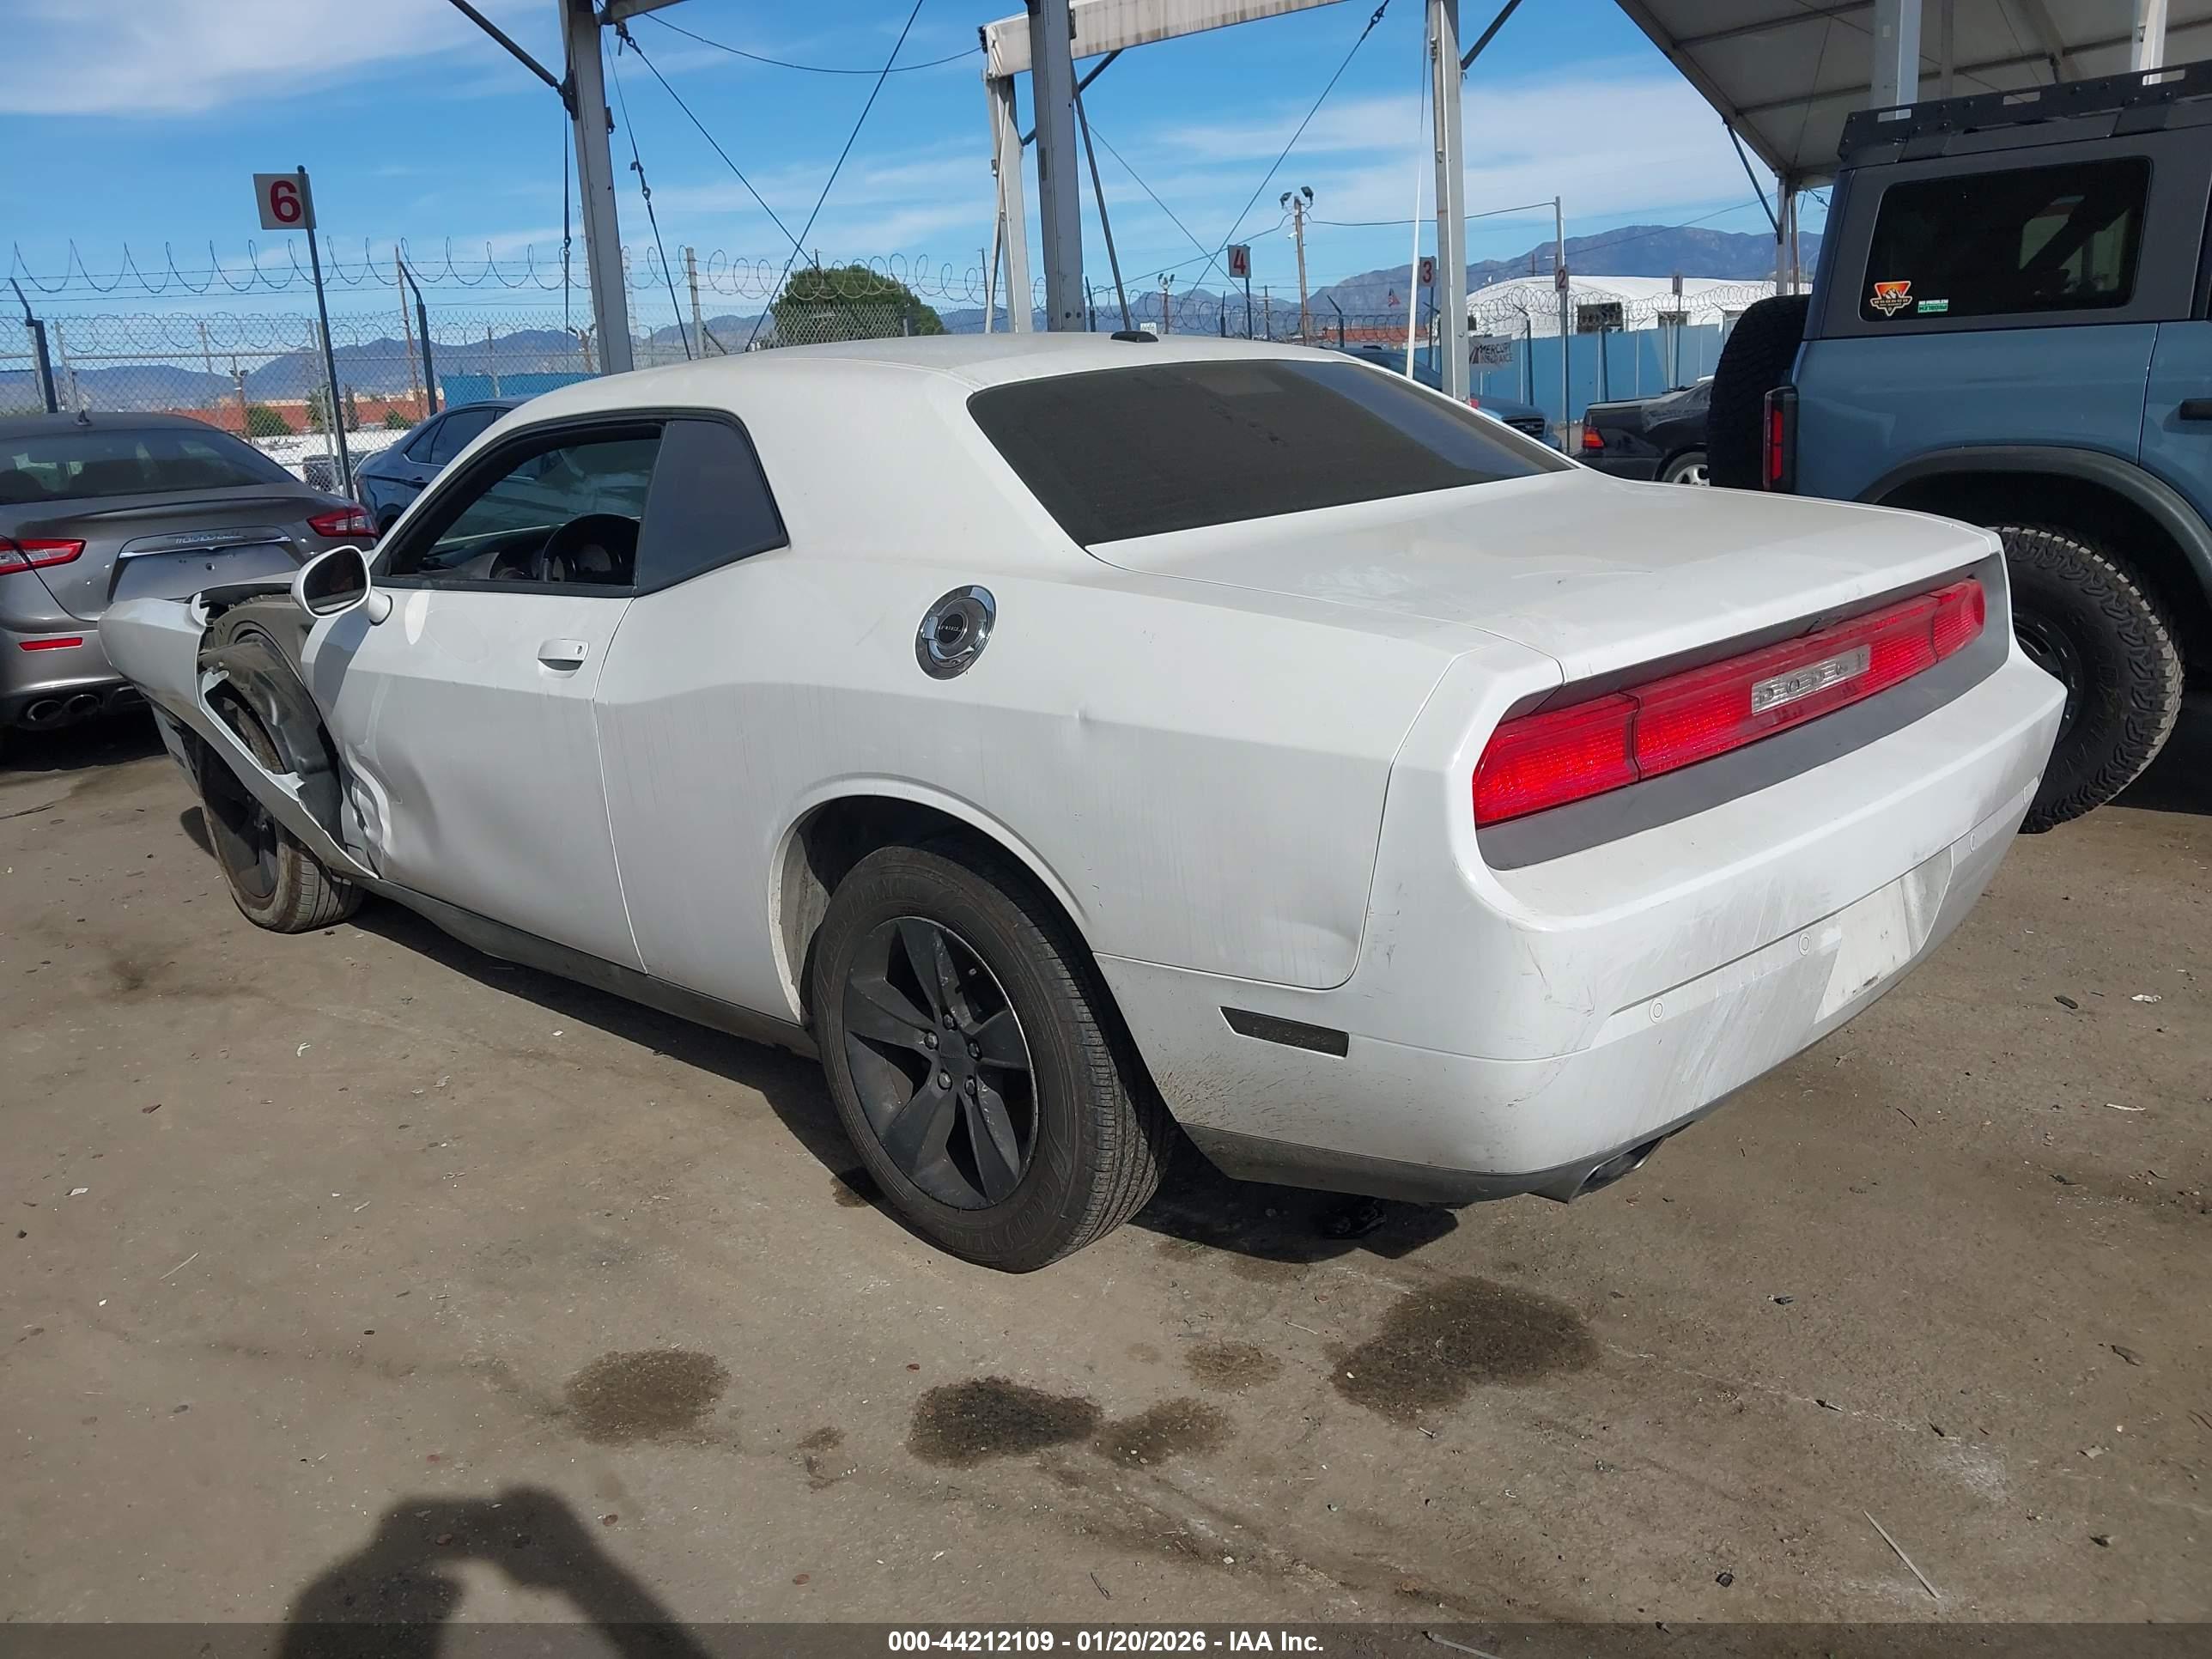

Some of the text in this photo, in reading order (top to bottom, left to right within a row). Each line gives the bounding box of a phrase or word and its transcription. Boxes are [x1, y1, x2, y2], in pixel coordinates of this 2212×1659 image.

[270, 180, 301, 223] 6
[1233, 249, 1246, 275] 4
[1423, 260, 1432, 283] 3
[1558, 269, 1566, 289] 2
[1674, 275, 1680, 293] 1
